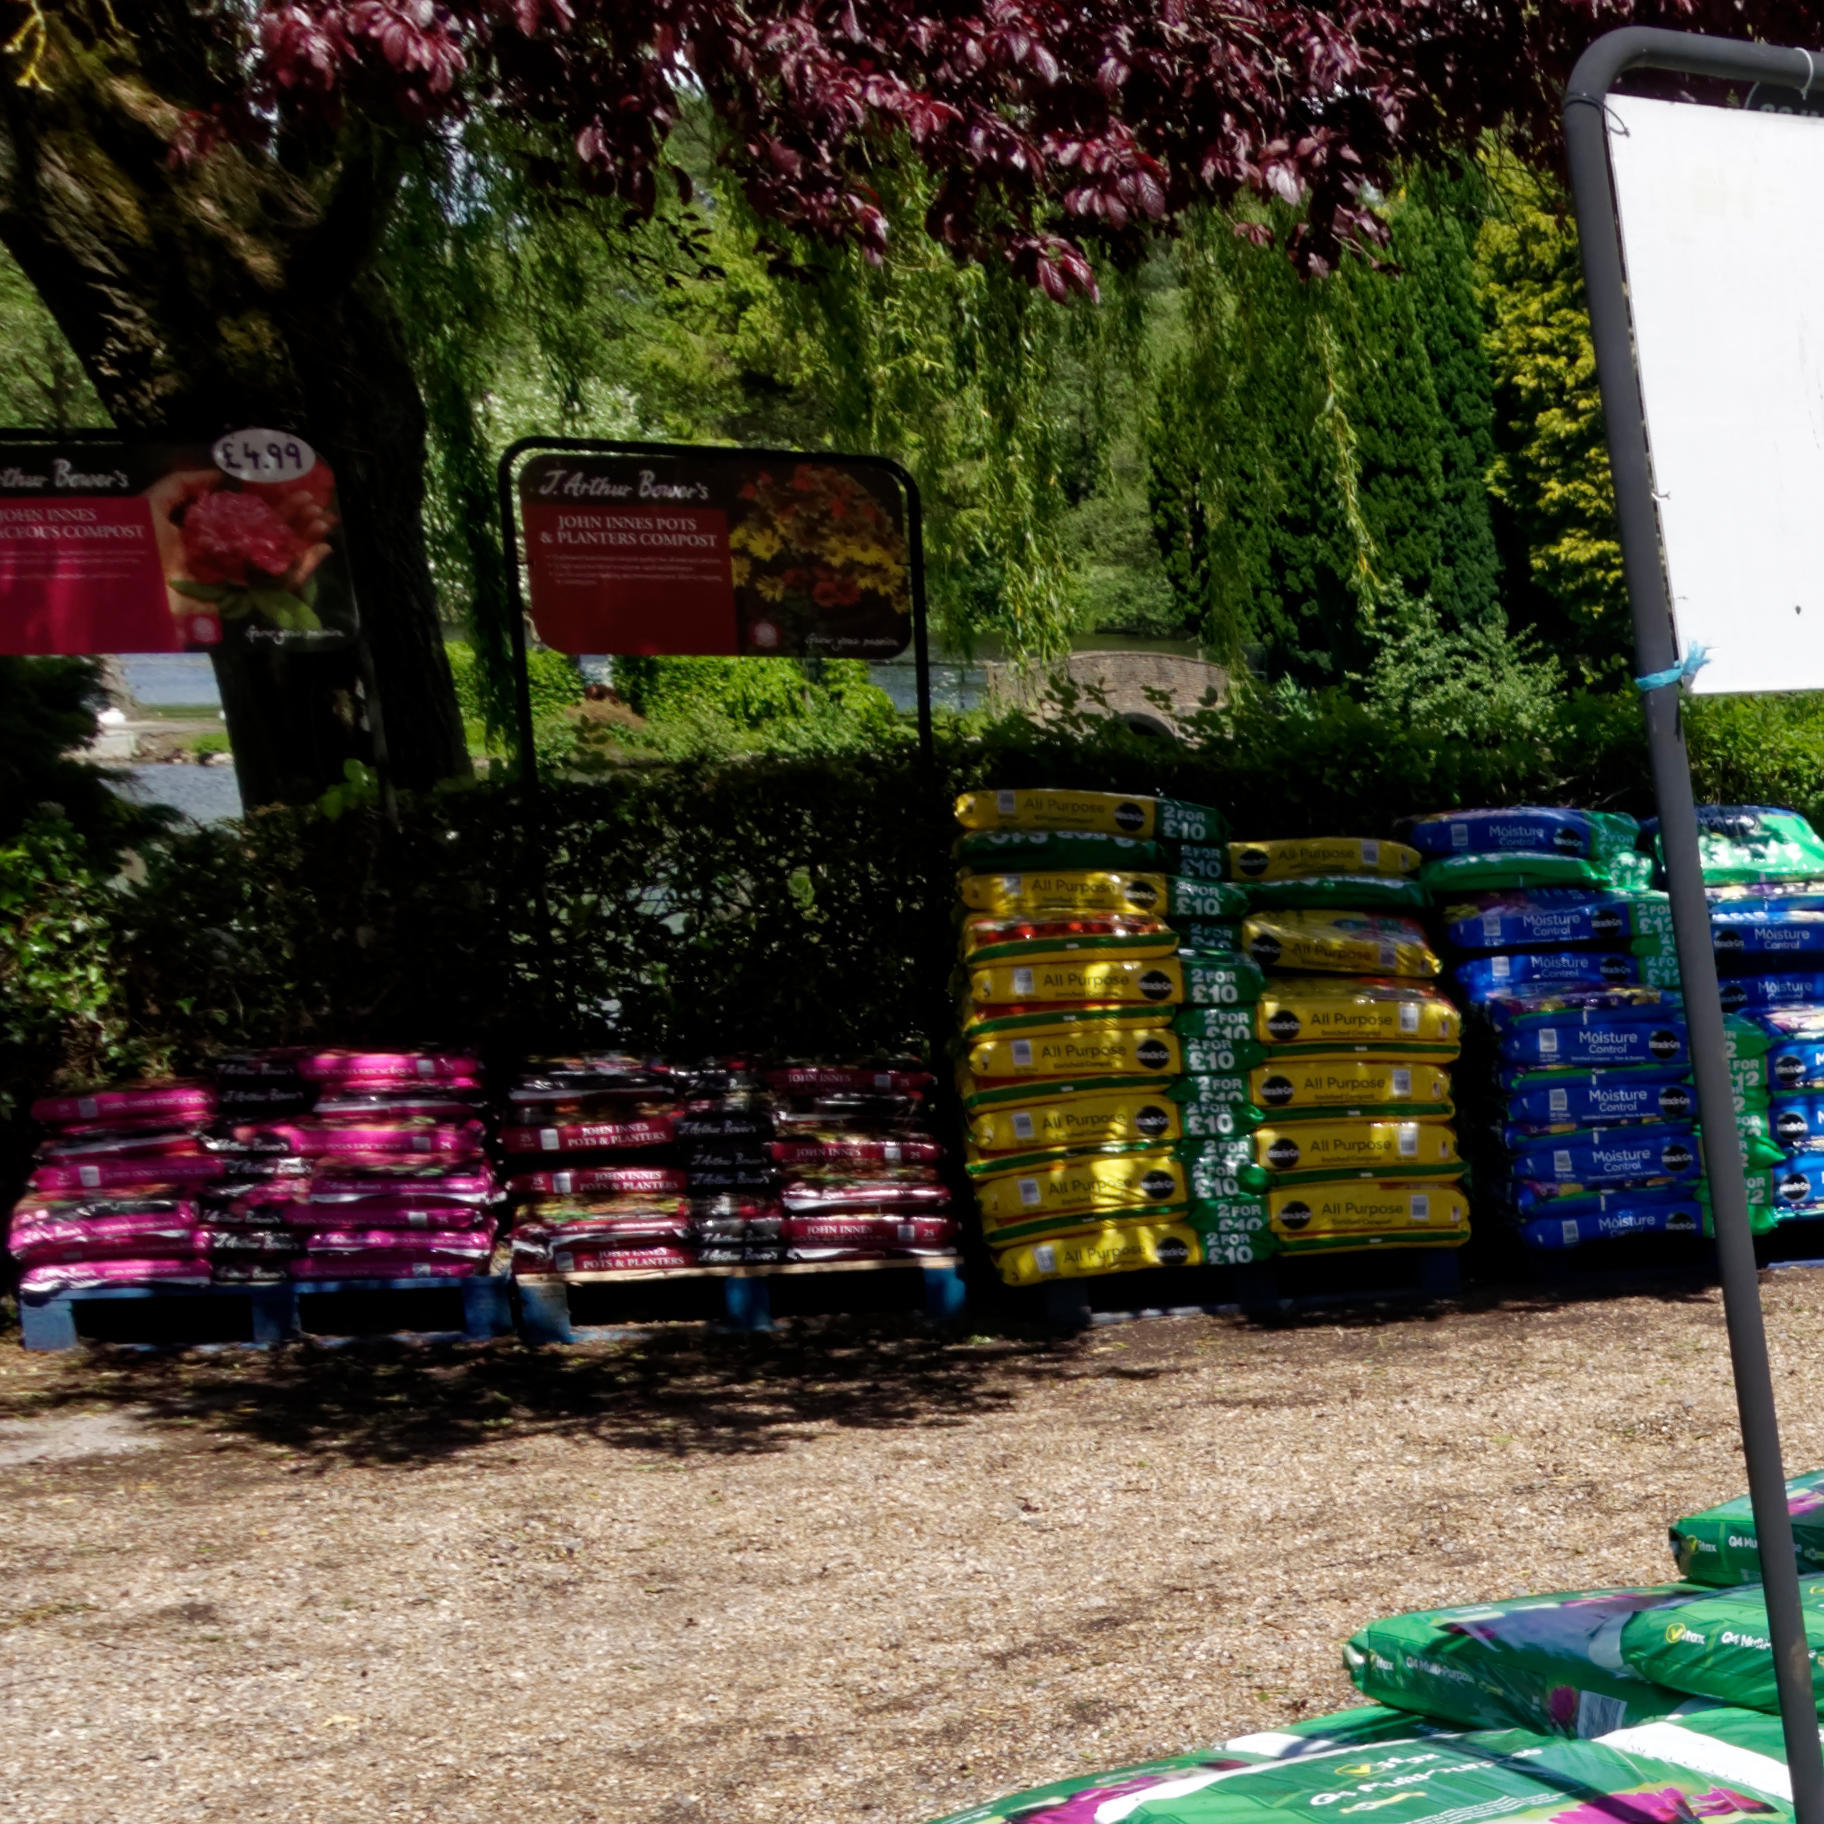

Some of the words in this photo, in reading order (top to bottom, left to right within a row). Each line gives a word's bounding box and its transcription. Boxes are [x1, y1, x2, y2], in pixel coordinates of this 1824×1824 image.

[221, 443, 302, 470] £4.99
[639, 470, 710, 500] Bower's
[558, 516, 601, 530] JOHN
[606, 517, 652, 530] INNES
[656, 518, 697, 531] POTS
[540, 533, 553, 544] &
[557, 532, 636, 546] PLANTERS
[640, 532, 717, 548] COMPOST
[1165, 805, 1176, 820] 2
[1176, 808, 1206, 823] FOR
[1165, 821, 1205, 840] £10
[1490, 826, 1543, 837] Moisture
[1524, 914, 1580, 927] Moisture
[1533, 926, 1571, 936] Control
[1044, 974, 1060, 987] All
[1064, 973, 1129, 989] Purpose
[1191, 968, 1203, 984] 2
[1206, 969, 1236, 984] FOR
[1193, 984, 1237, 1003] £10
[1311, 1014, 1328, 1027] All
[1333, 1013, 1393, 1029] Purpose
